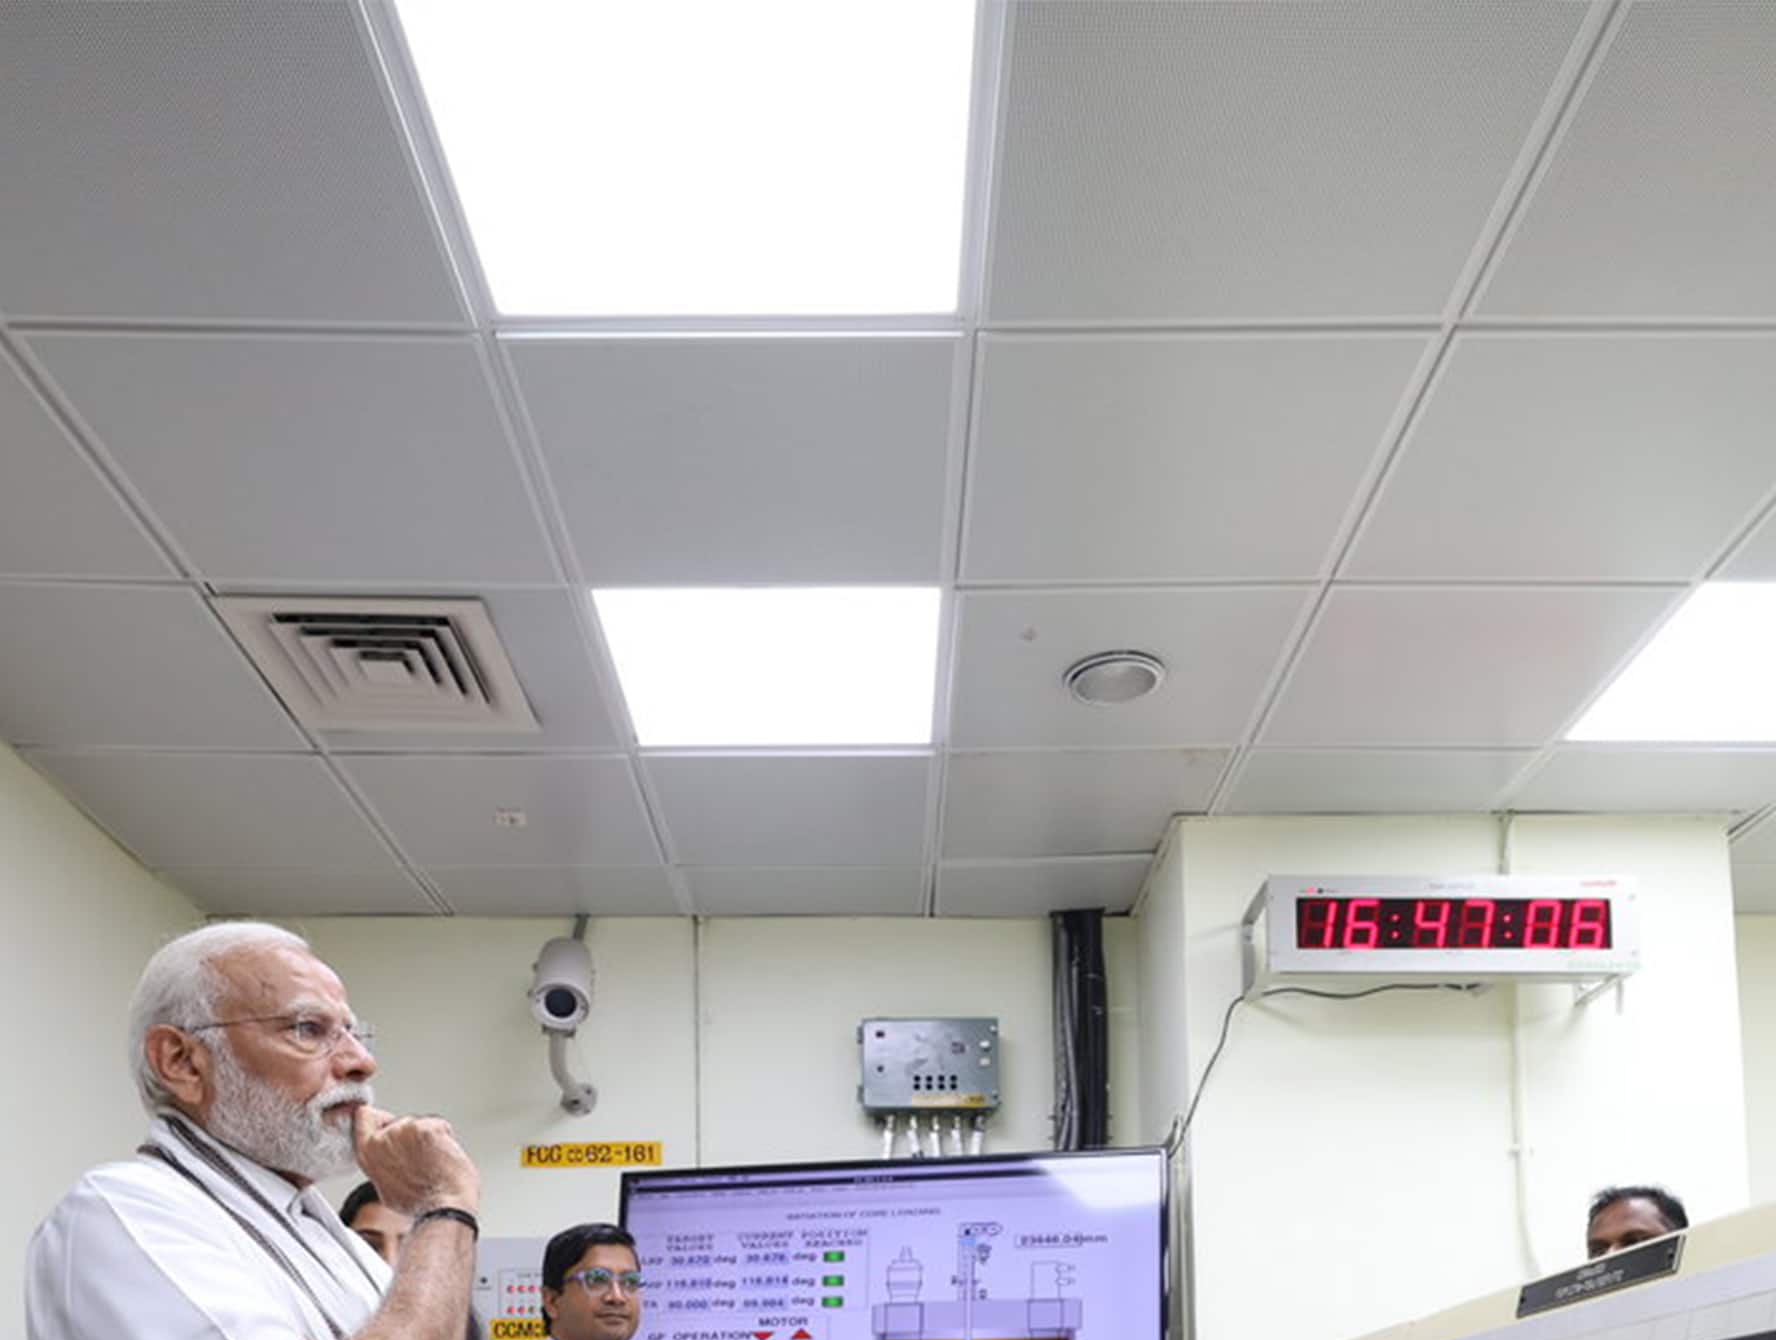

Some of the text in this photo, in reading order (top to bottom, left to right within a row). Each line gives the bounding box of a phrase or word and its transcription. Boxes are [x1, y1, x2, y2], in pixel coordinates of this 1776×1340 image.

[1321, 898, 1609, 951] 16:47:06
[713, 1254, 737, 1265] deg
[792, 1251, 817, 1262] deg
[713, 1279, 737, 1290] deg
[791, 1276, 816, 1288] deg
[711, 1297, 735, 1308] deg
[791, 1296, 815, 1307] deg
[758, 1316, 808, 1327] MOTOR
